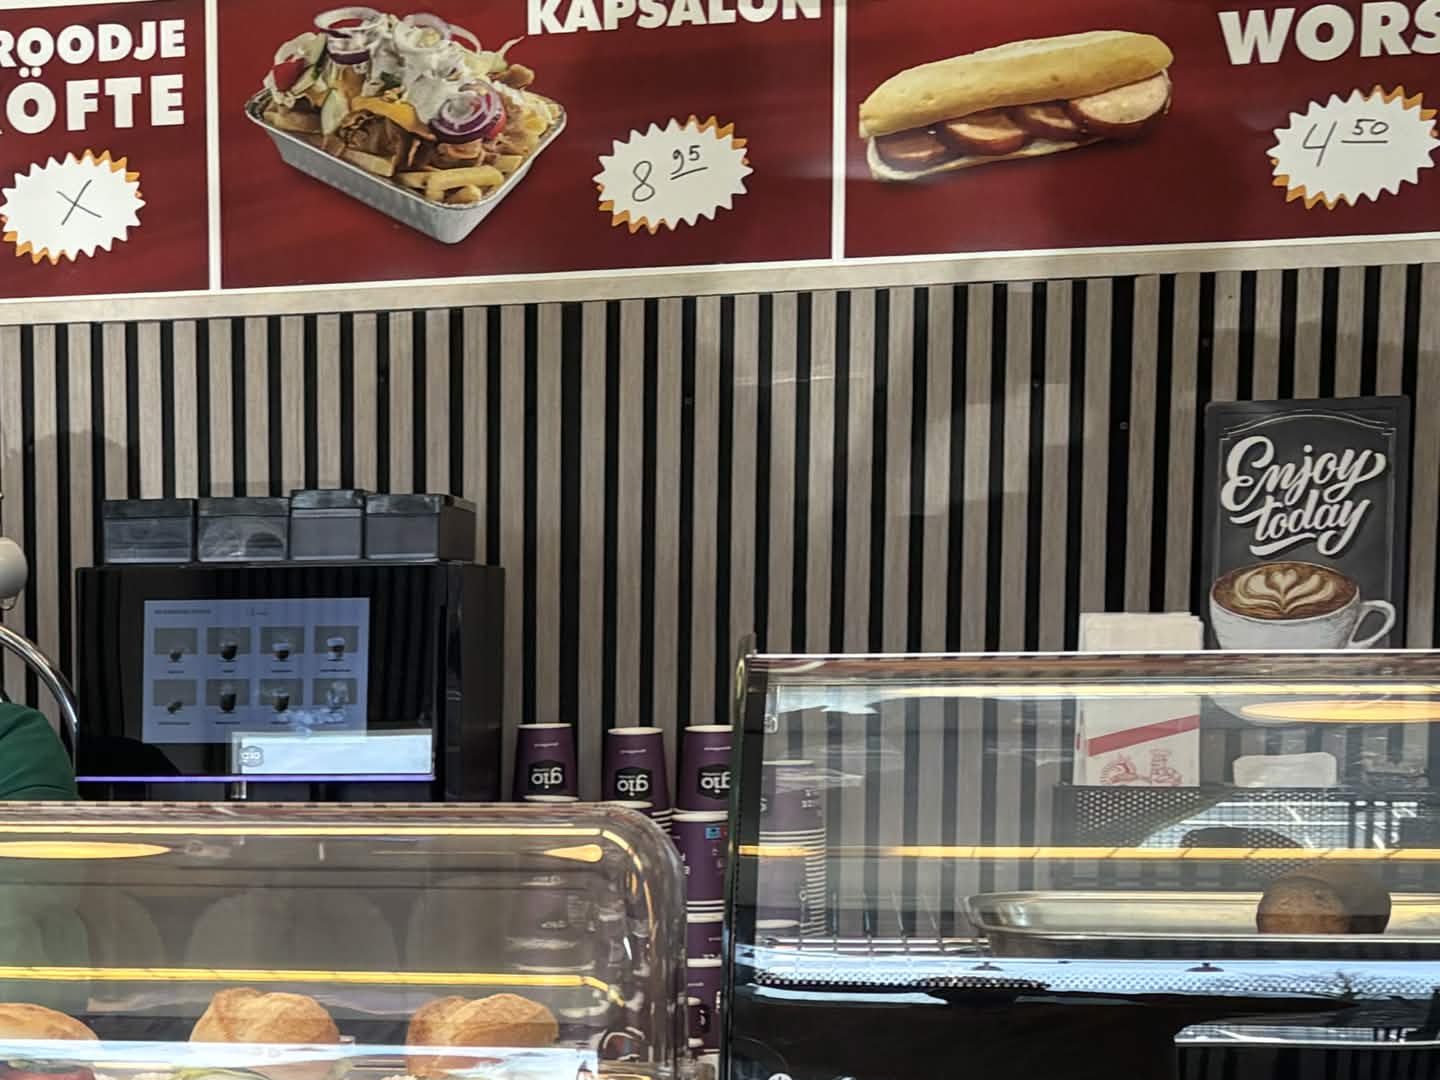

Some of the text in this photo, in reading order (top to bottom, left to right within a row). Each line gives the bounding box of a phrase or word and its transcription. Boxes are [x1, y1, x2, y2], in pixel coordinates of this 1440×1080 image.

[1302, 118, 1389, 167] 4 50
[632, 145, 701, 202] 8 95
[1220, 435, 1387, 512] Enjoy
[1229, 489, 1371, 556] today
[531, 767, 563, 789] gio
[617, 774, 650, 797] gio
